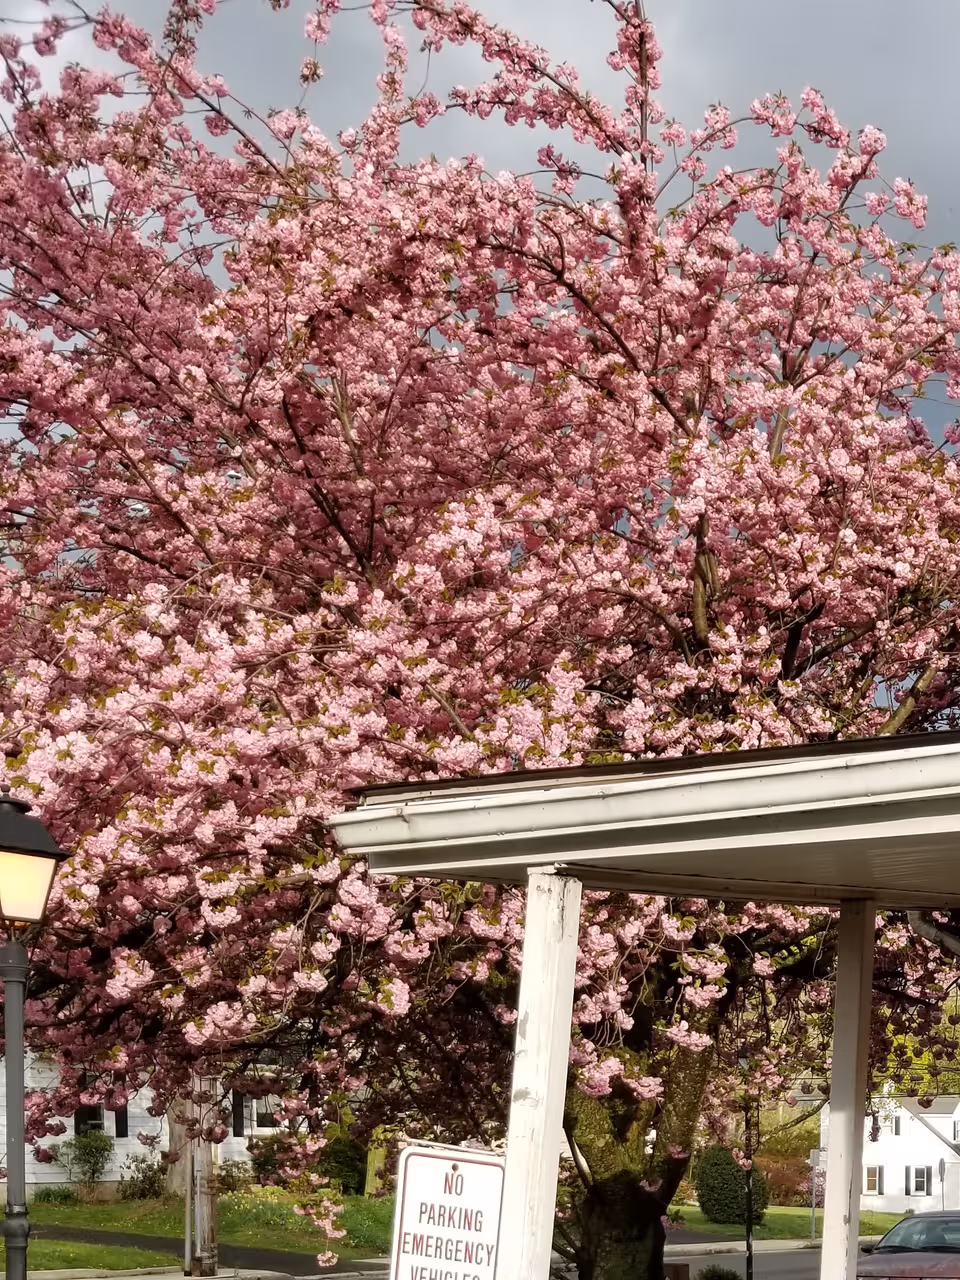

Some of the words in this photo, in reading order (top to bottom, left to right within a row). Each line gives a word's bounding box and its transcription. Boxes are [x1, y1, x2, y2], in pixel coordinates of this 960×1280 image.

[443, 1172, 464, 1196] NO
[418, 1202, 484, 1232] PARKING
[402, 1232, 494, 1266] EMERGENCY
